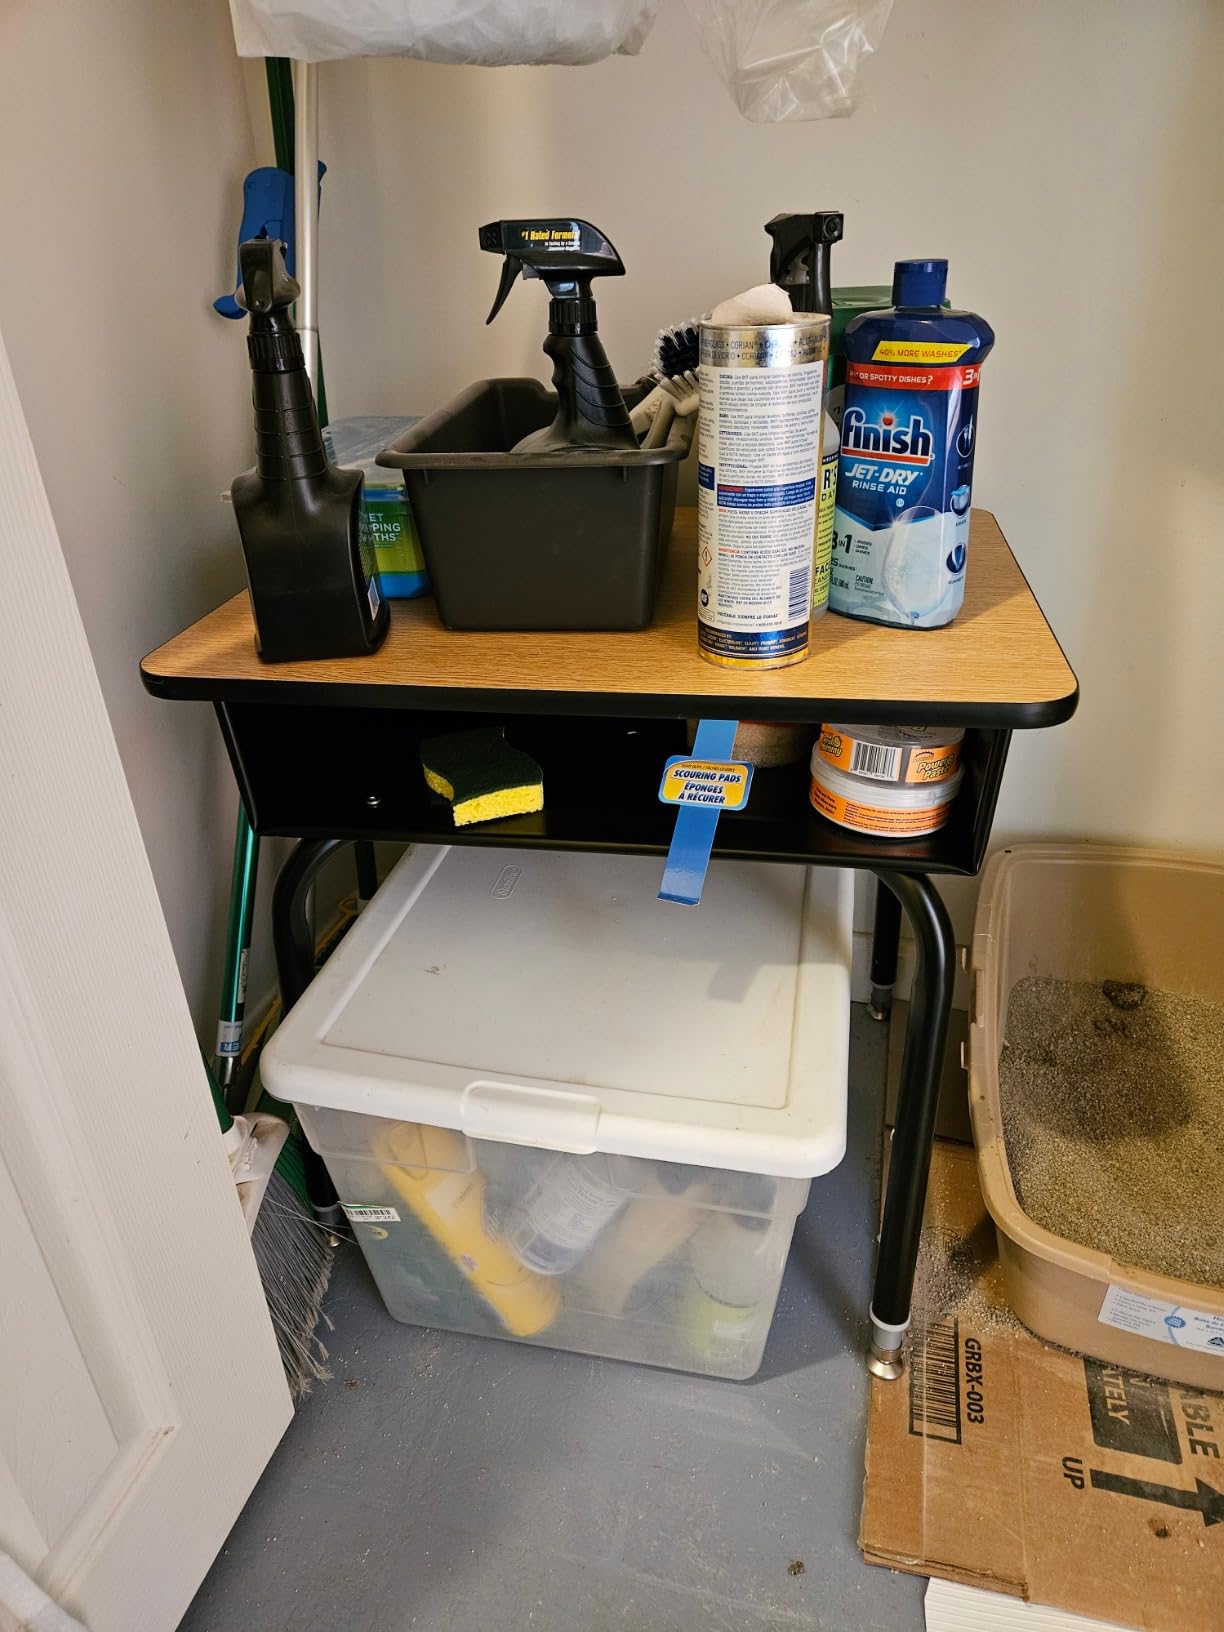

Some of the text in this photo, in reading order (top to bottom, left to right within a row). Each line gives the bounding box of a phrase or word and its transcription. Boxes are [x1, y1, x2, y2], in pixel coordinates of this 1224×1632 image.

[530, 230, 550, 240] Rated
[896, 350, 919, 358] MORE
[870, 373, 898, 382] SPOTTY
[898, 375, 934, 384] DISHES?
[842, 408, 931, 459] finish
[845, 463, 919, 486] JET-DRY
[852, 480, 907, 496] RINSE AID
[674, 769, 742, 783] SCOURING PADS
[684, 780, 723, 794] ÉPONGES
[678, 792, 726, 804] À RÉCURER
[964, 1337, 985, 1425] GRBX-003
[1061, 1456, 1086, 1490] UP
